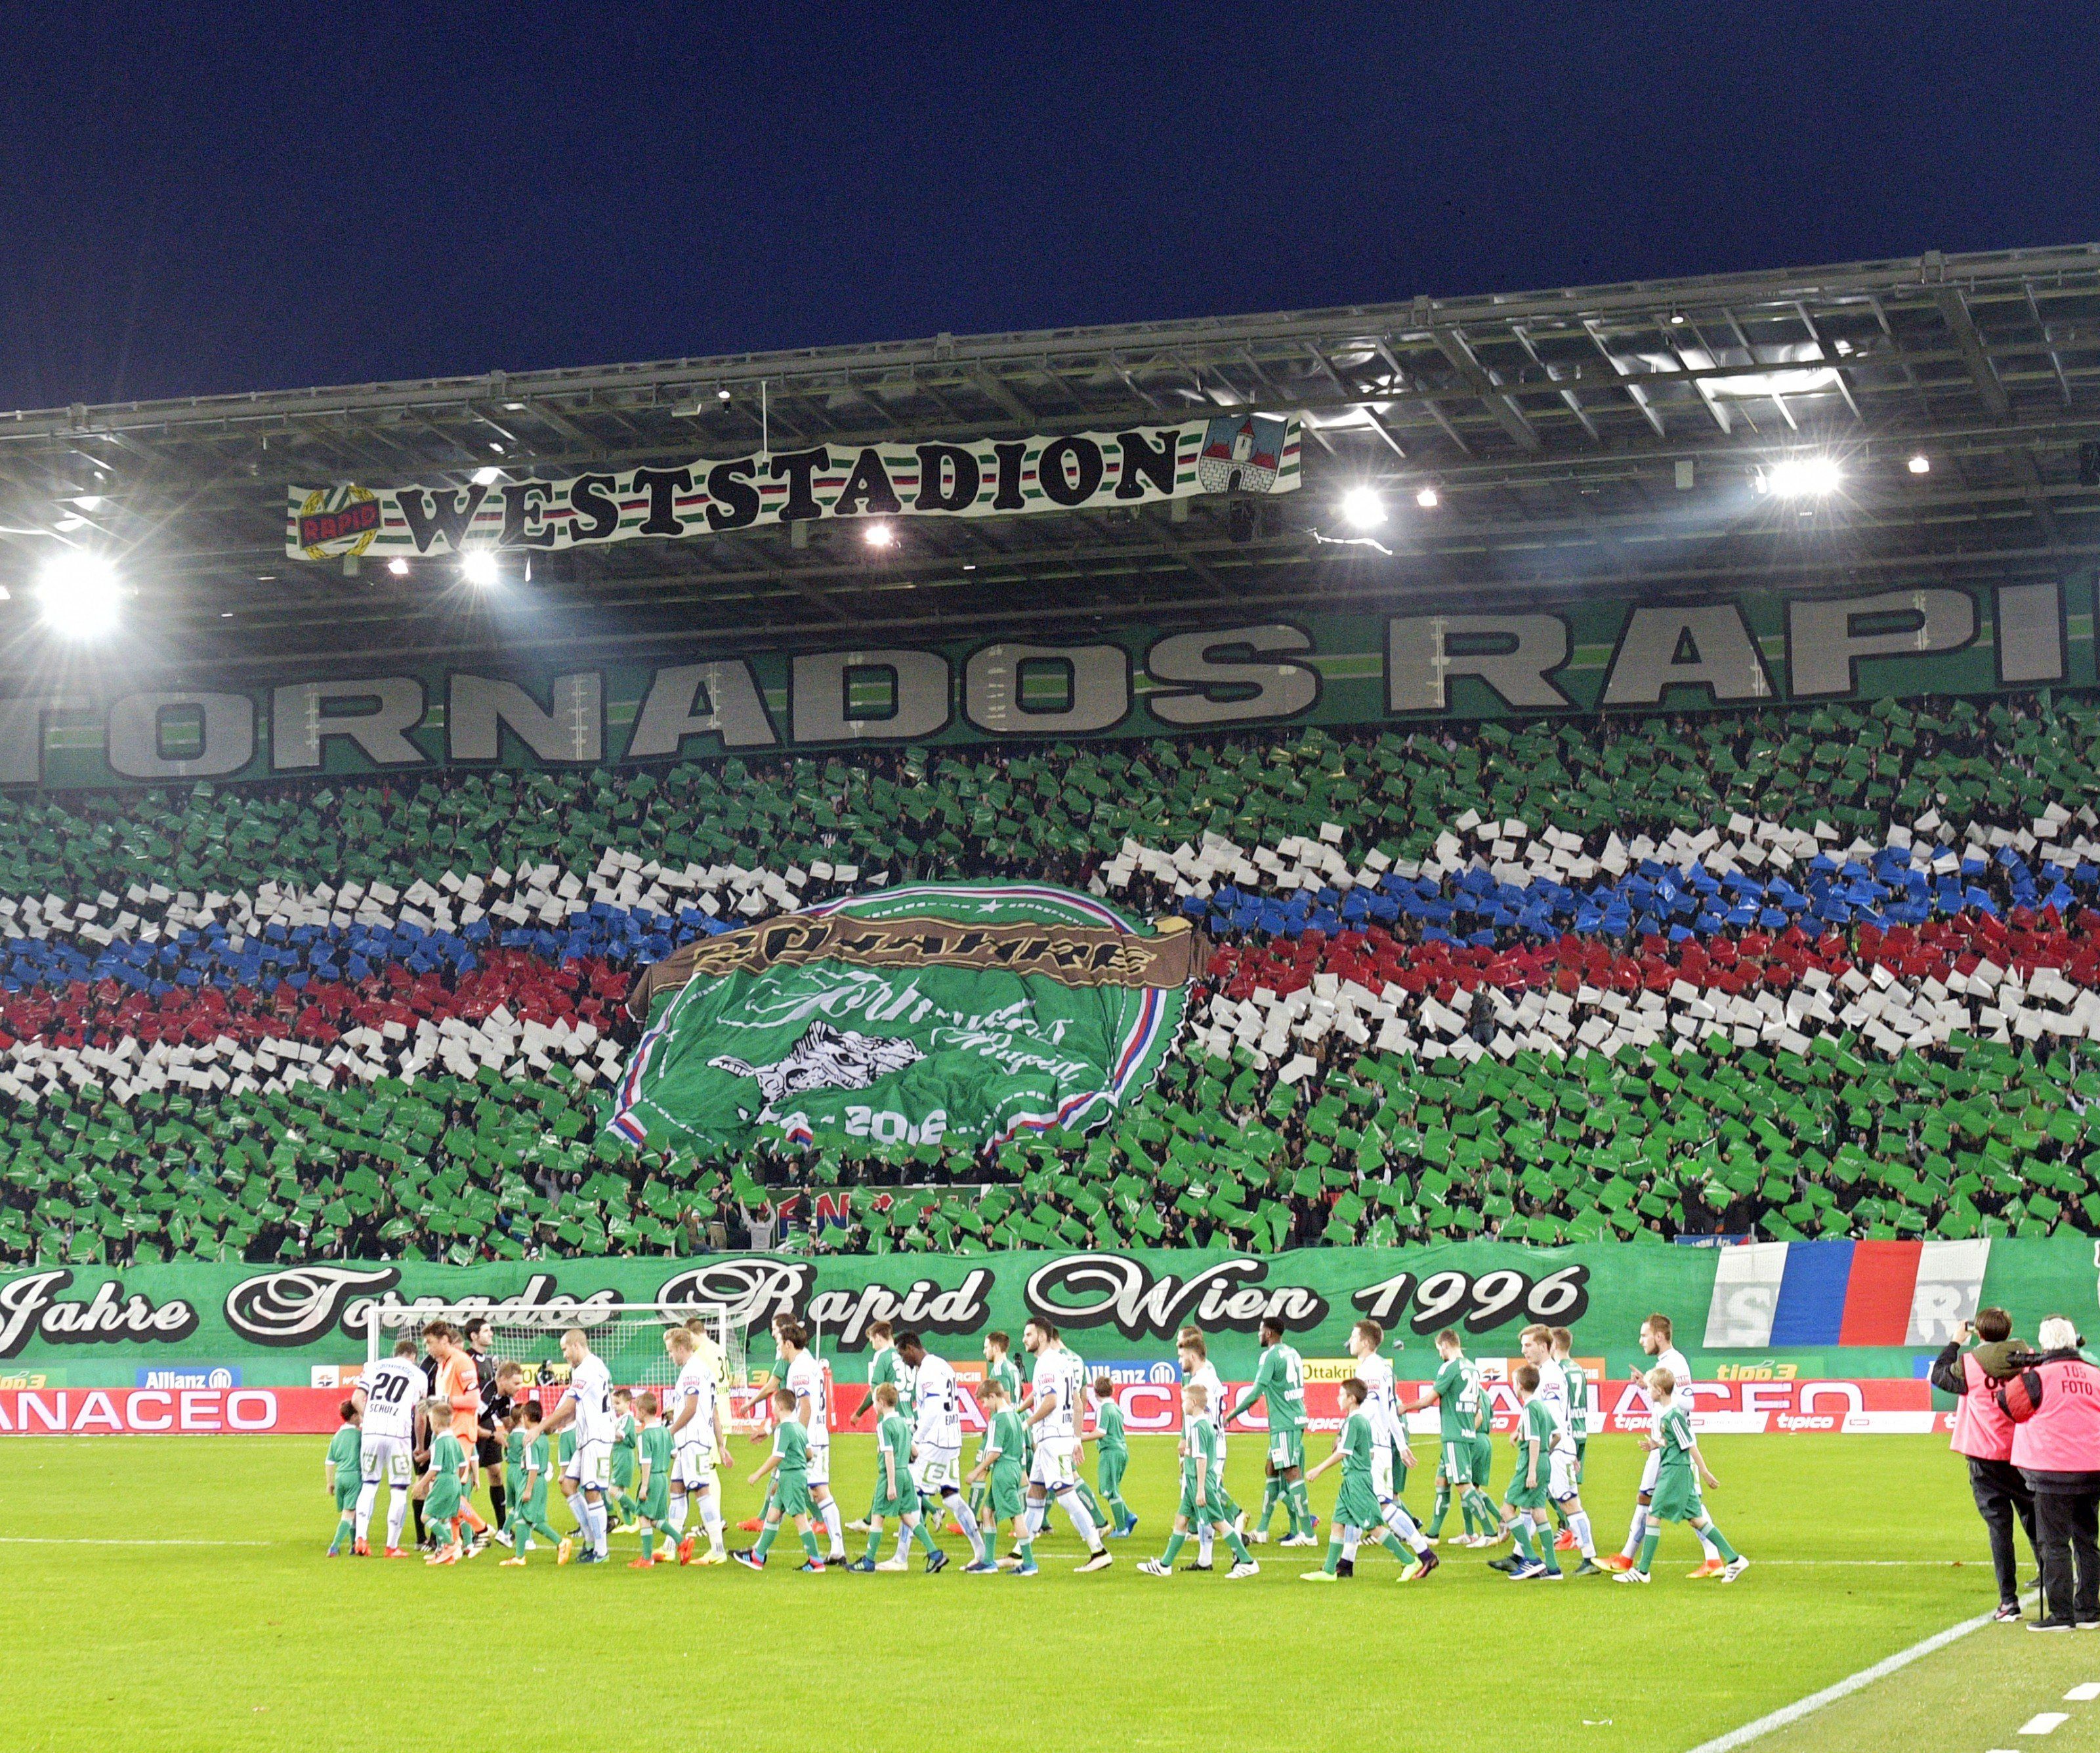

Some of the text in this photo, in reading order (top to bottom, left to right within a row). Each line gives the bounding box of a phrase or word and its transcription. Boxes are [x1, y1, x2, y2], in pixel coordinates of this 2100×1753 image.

[395, 430, 1181, 553] WESTSTADION
[304, 505, 376, 541] RAPID
[0, 579, 2100, 782] TORNADOS RAPI
[0, 1254, 1589, 1359] Jahre Tornados Rapid Wien 1996
[145, 1372, 206, 1389] Allianz
[370, 1372, 410, 1404] 20
[1570, 1373, 1583, 1407] 7
[2061, 1380, 2093, 1395] FOTO
[0, 1391, 277, 1431] NACEO
[1776, 1412, 1834, 1431] tipico
